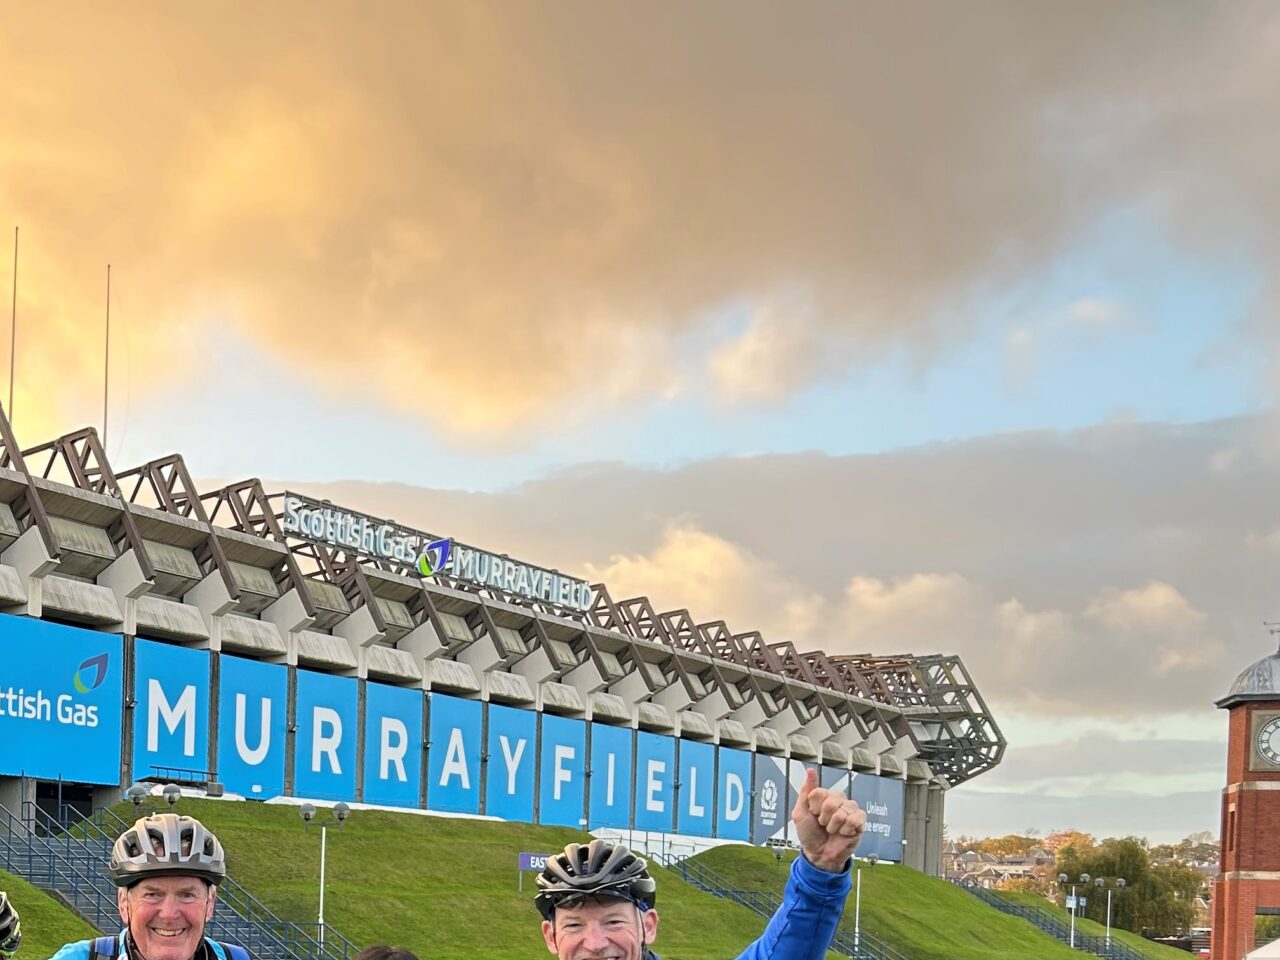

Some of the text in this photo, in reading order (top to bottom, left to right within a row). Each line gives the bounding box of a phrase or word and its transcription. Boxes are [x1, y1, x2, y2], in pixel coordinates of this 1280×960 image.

[284, 496, 593, 612] Scottish Gas MURRAYFIELD
[57, 694, 99, 728] Gas
[147, 678, 744, 822] MURRAYFIELD
